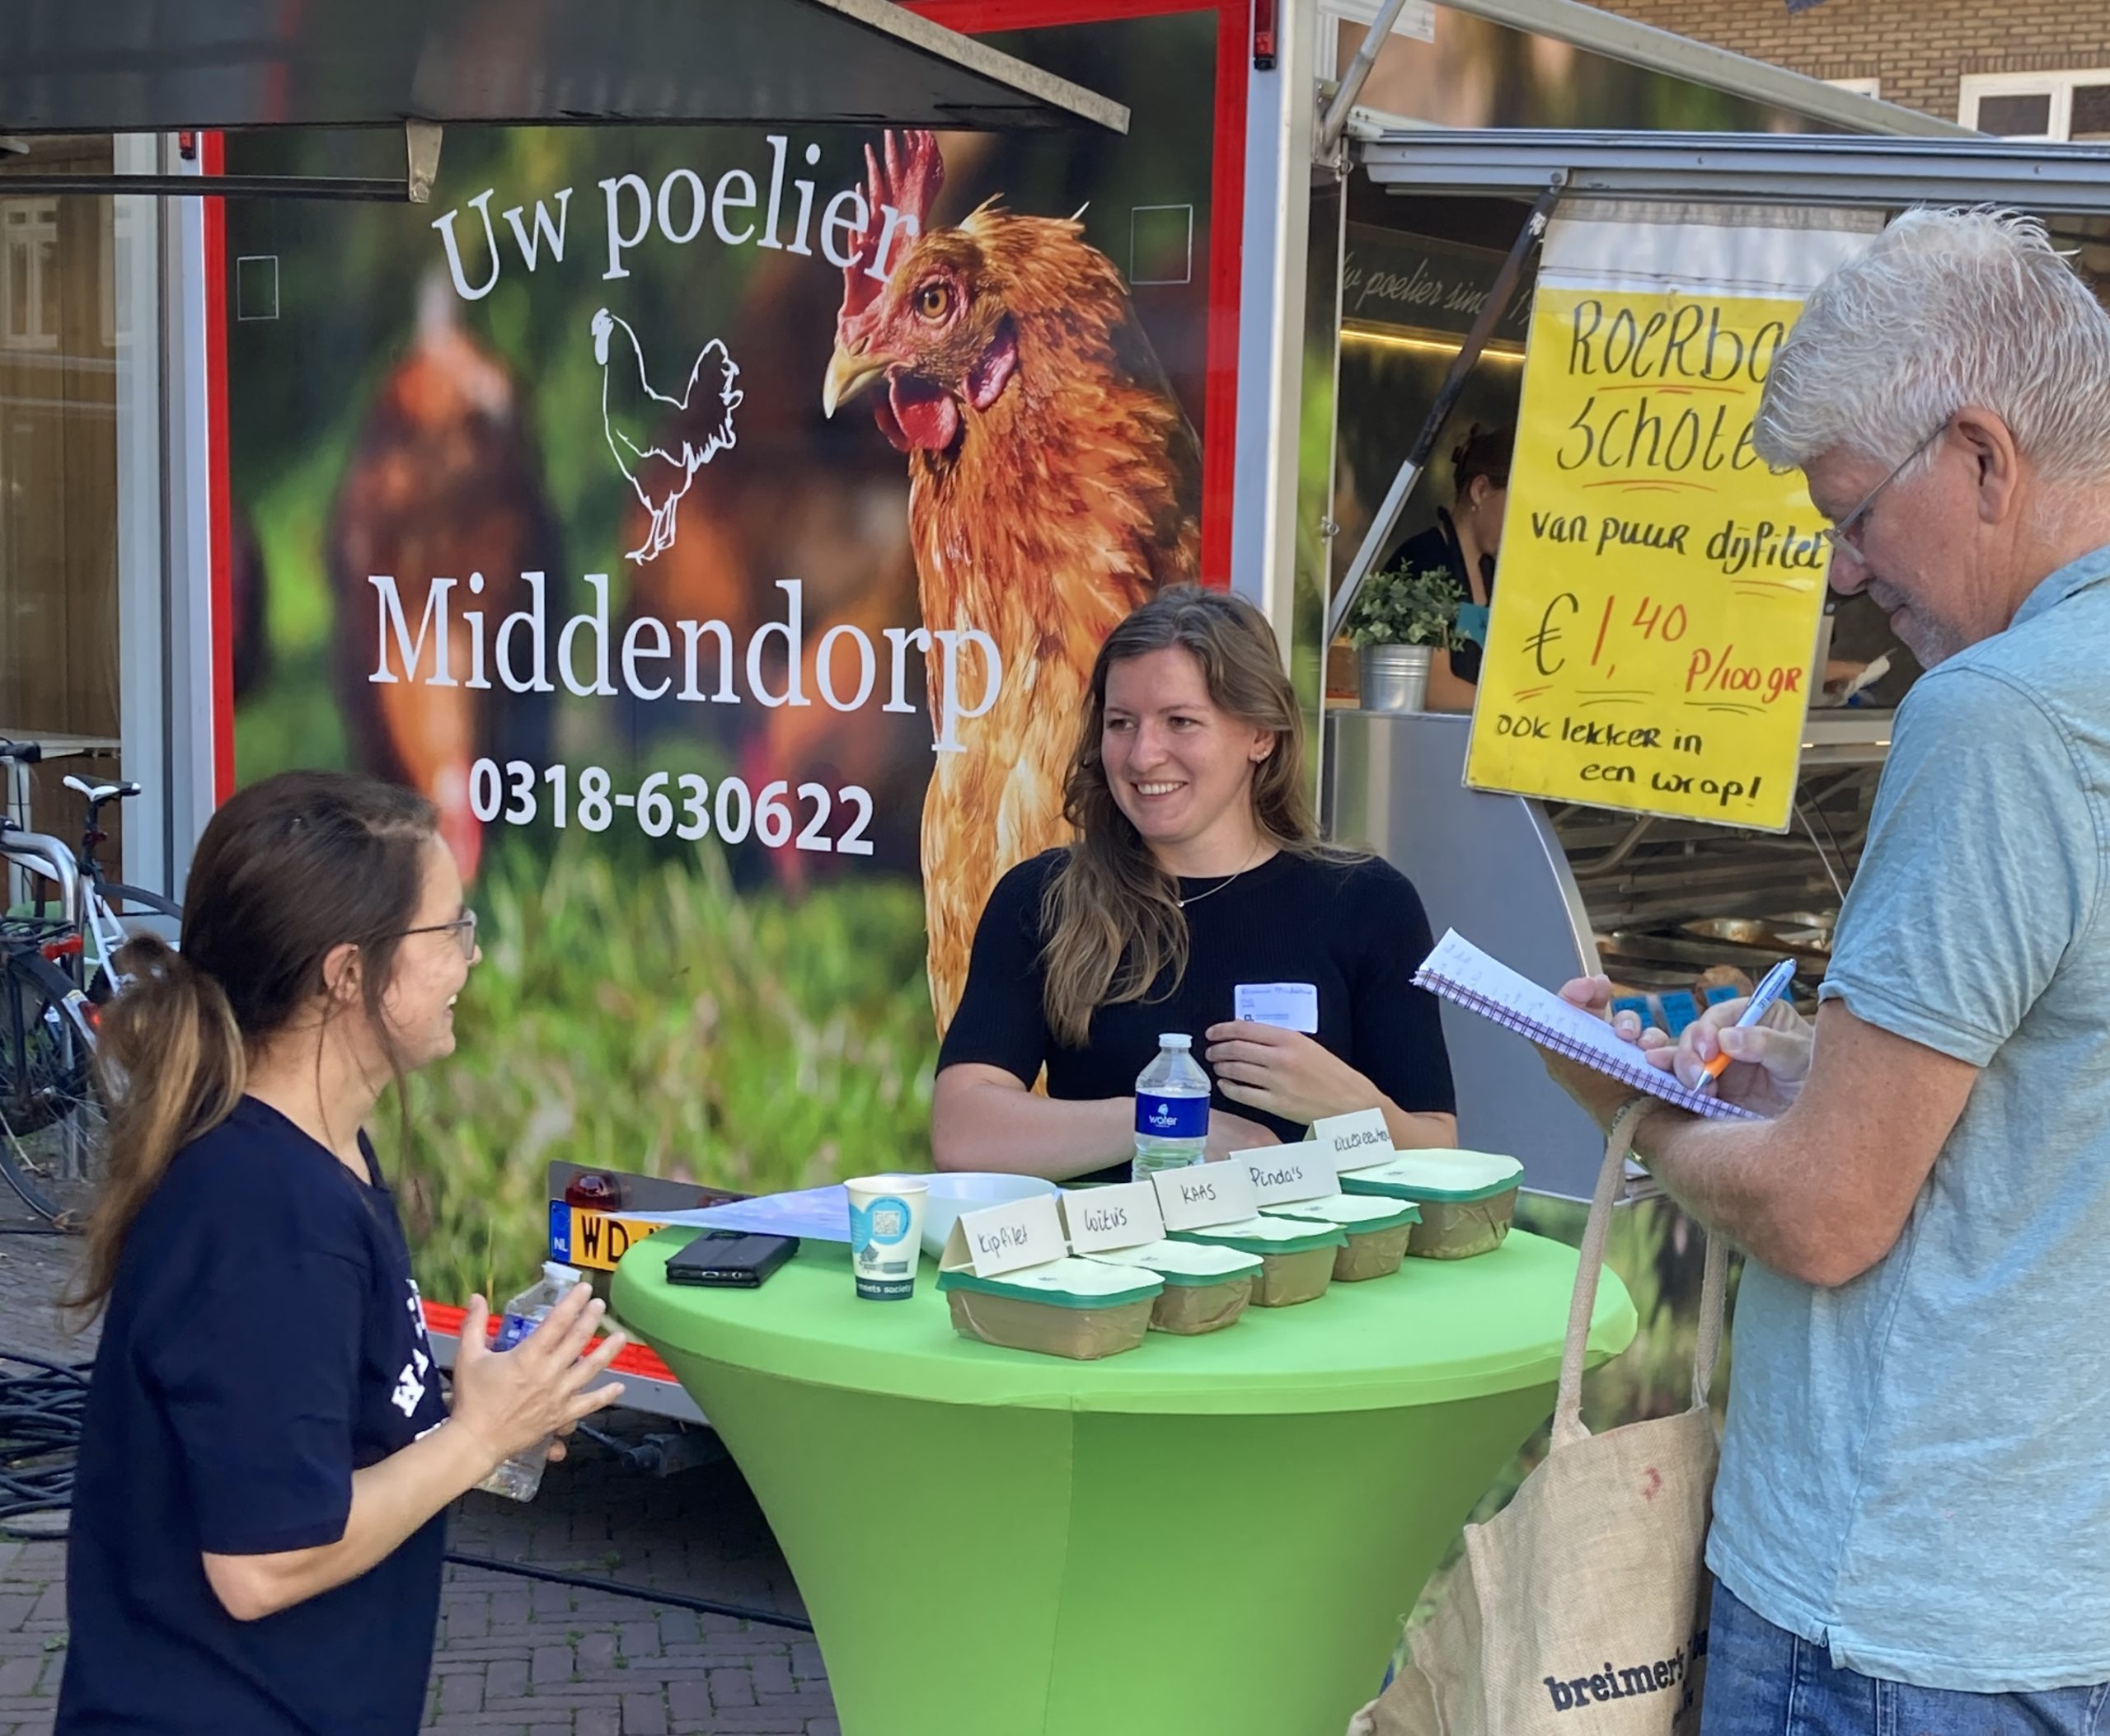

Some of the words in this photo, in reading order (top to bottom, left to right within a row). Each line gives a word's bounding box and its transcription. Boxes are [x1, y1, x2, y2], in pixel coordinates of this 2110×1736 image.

[431, 187, 572, 300] Uw
[598, 135, 919, 282] poelier
[1354, 257, 1442, 310] poelier
[1532, 509, 1589, 544] van
[368, 570, 1003, 753] Middendorp
[1497, 714, 1552, 739] ook
[1674, 730, 1703, 756] in
[469, 757, 874, 856] 0318-630622
[1580, 763, 1636, 783] een
[1651, 774, 1762, 807] wrap!
[1180, 1183, 1217, 1204] KAAS
[1249, 1166, 1303, 1188] Pinda's
[553, 1236, 569, 1252] NL
